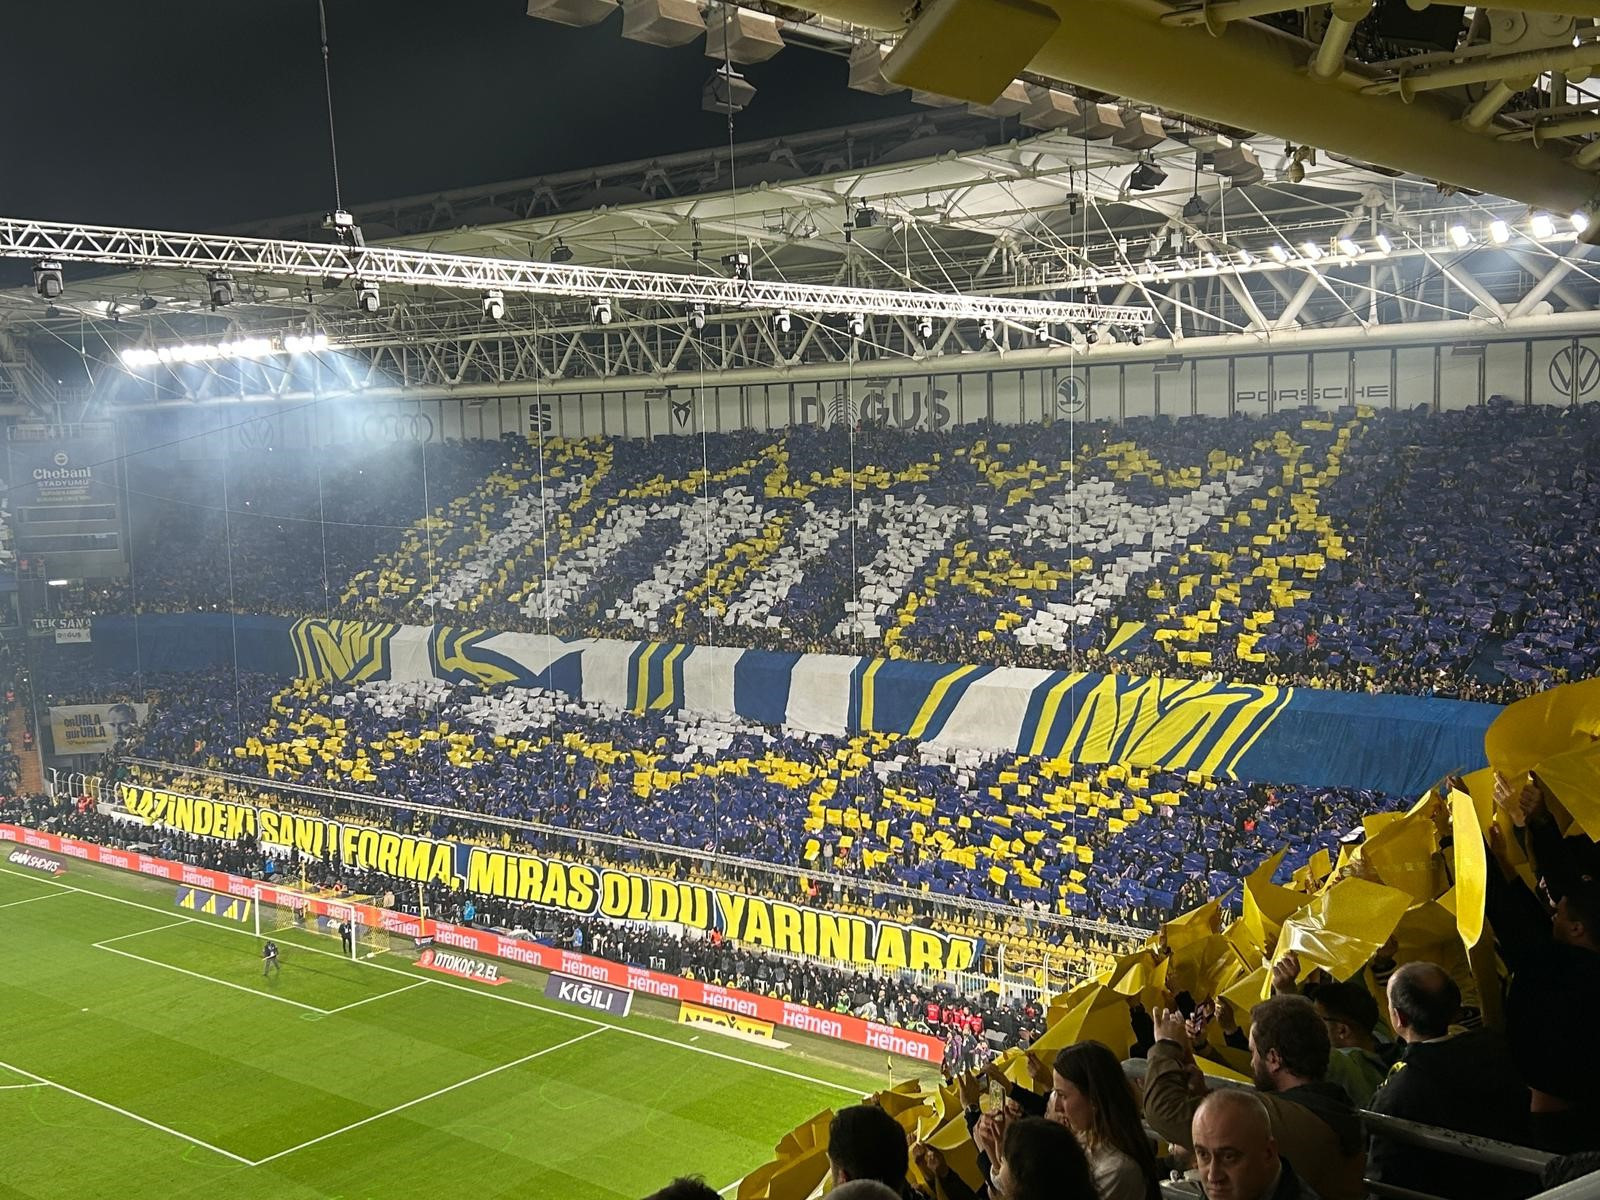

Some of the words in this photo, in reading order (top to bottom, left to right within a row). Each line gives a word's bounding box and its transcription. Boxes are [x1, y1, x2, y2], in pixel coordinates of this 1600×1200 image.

[1237, 385, 1389, 403] PORSCHE
[33, 466, 92, 480] Chobani
[38, 480, 89, 488] STADYUMU
[139, 861, 170, 878] Hemen
[182, 870, 215, 888] Hemen
[381, 917, 420, 937] Hemen
[601, 872, 709, 930] OLDU
[715, 890, 973, 971] YARINLARA
[435, 929, 478, 950] Hemen
[497, 943, 543, 965] Hemen
[434, 953, 476, 977] OTOKOÇ
[476, 961, 499, 981] 2.EL
[562, 959, 608, 982] Hemen
[627, 974, 679, 999] Hemen
[702, 991, 758, 1017] Hemen
[782, 1010, 843, 1039] Hemen
[865, 1029, 929, 1060] Hemen
